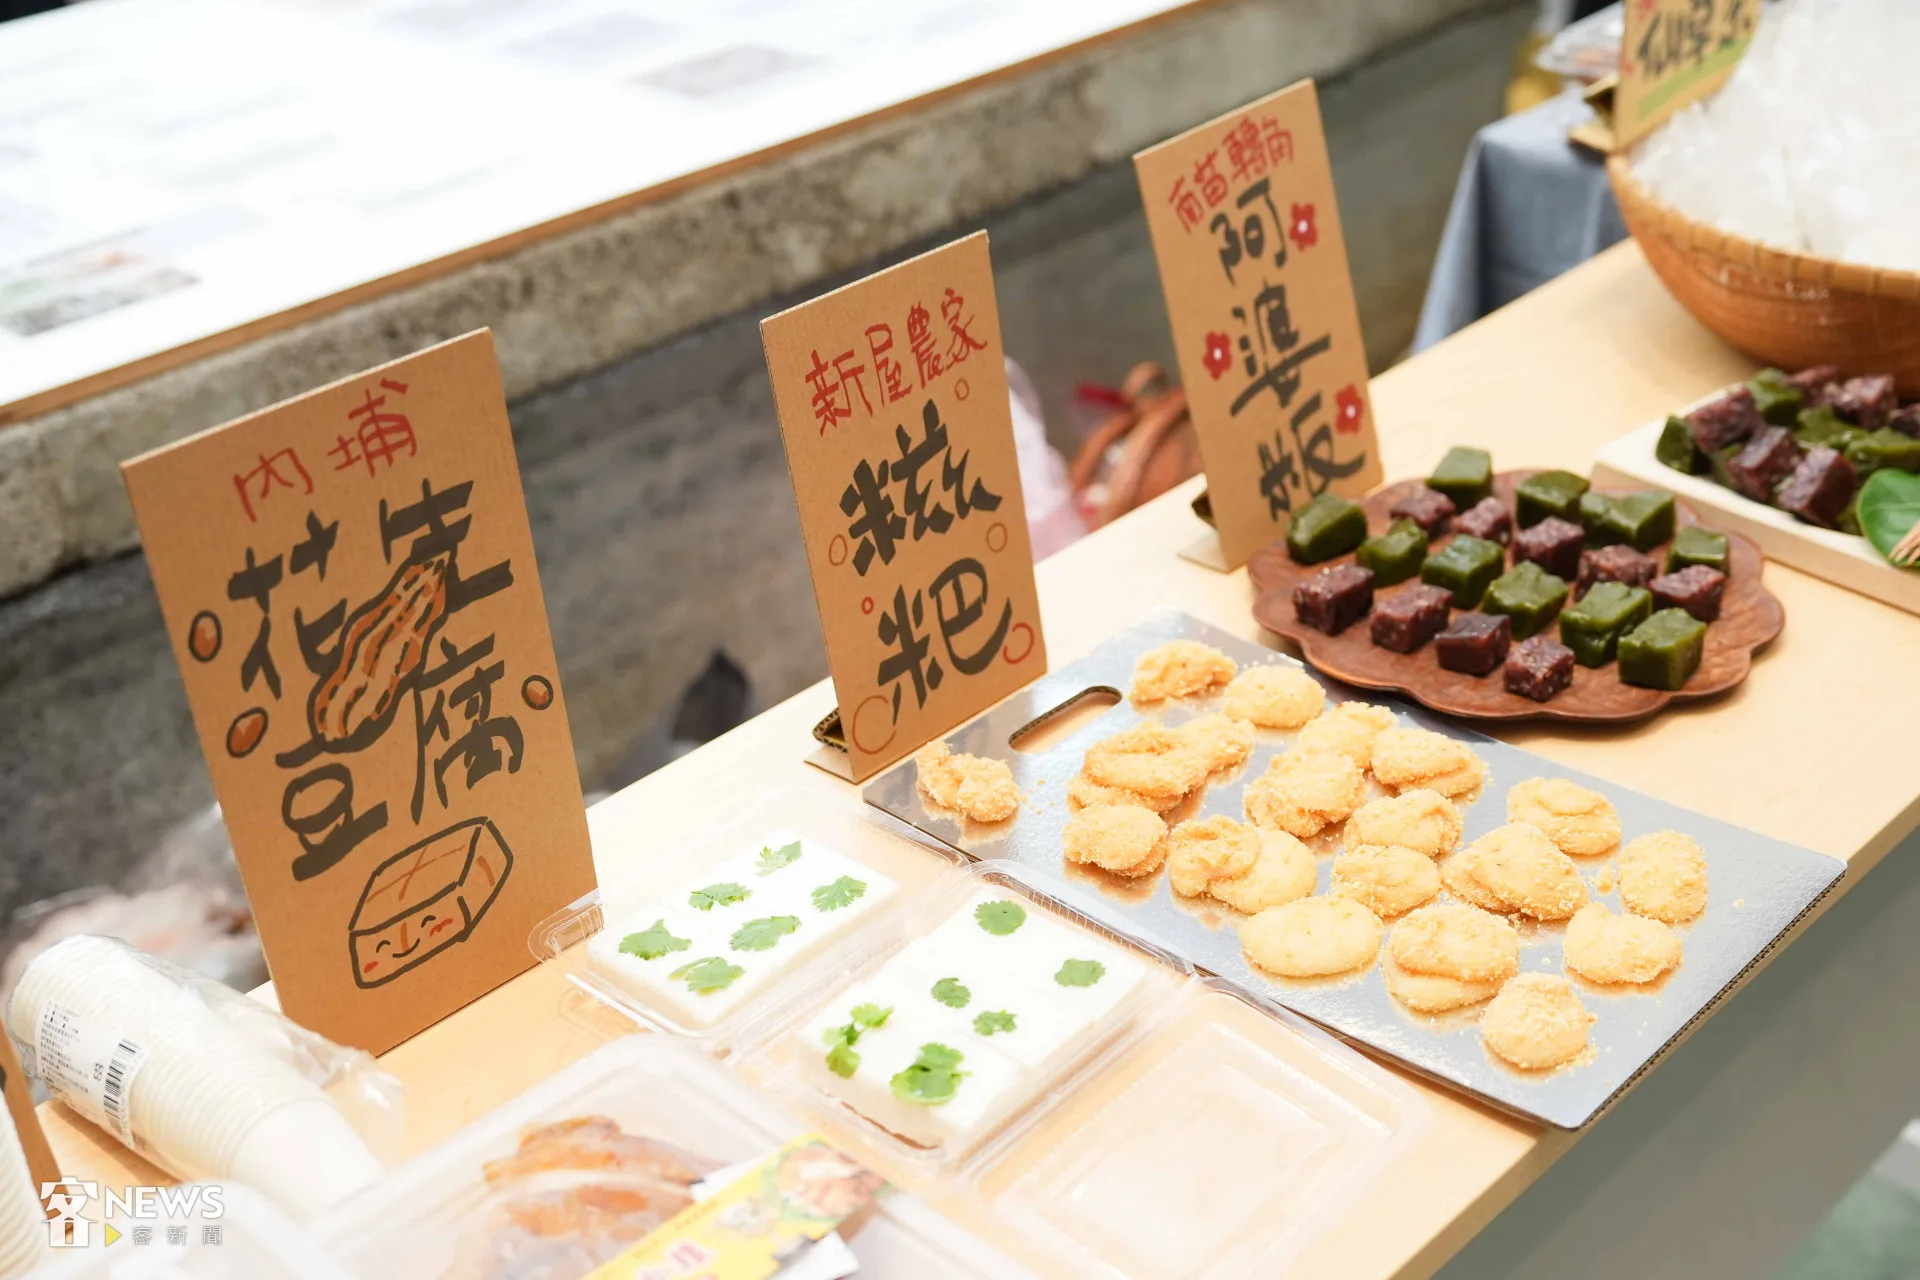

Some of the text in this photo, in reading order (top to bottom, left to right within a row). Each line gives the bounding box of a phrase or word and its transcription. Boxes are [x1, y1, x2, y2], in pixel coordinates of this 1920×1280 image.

[805, 286, 988, 438] 新屋農家
[275, 633, 524, 882] 豆腐
